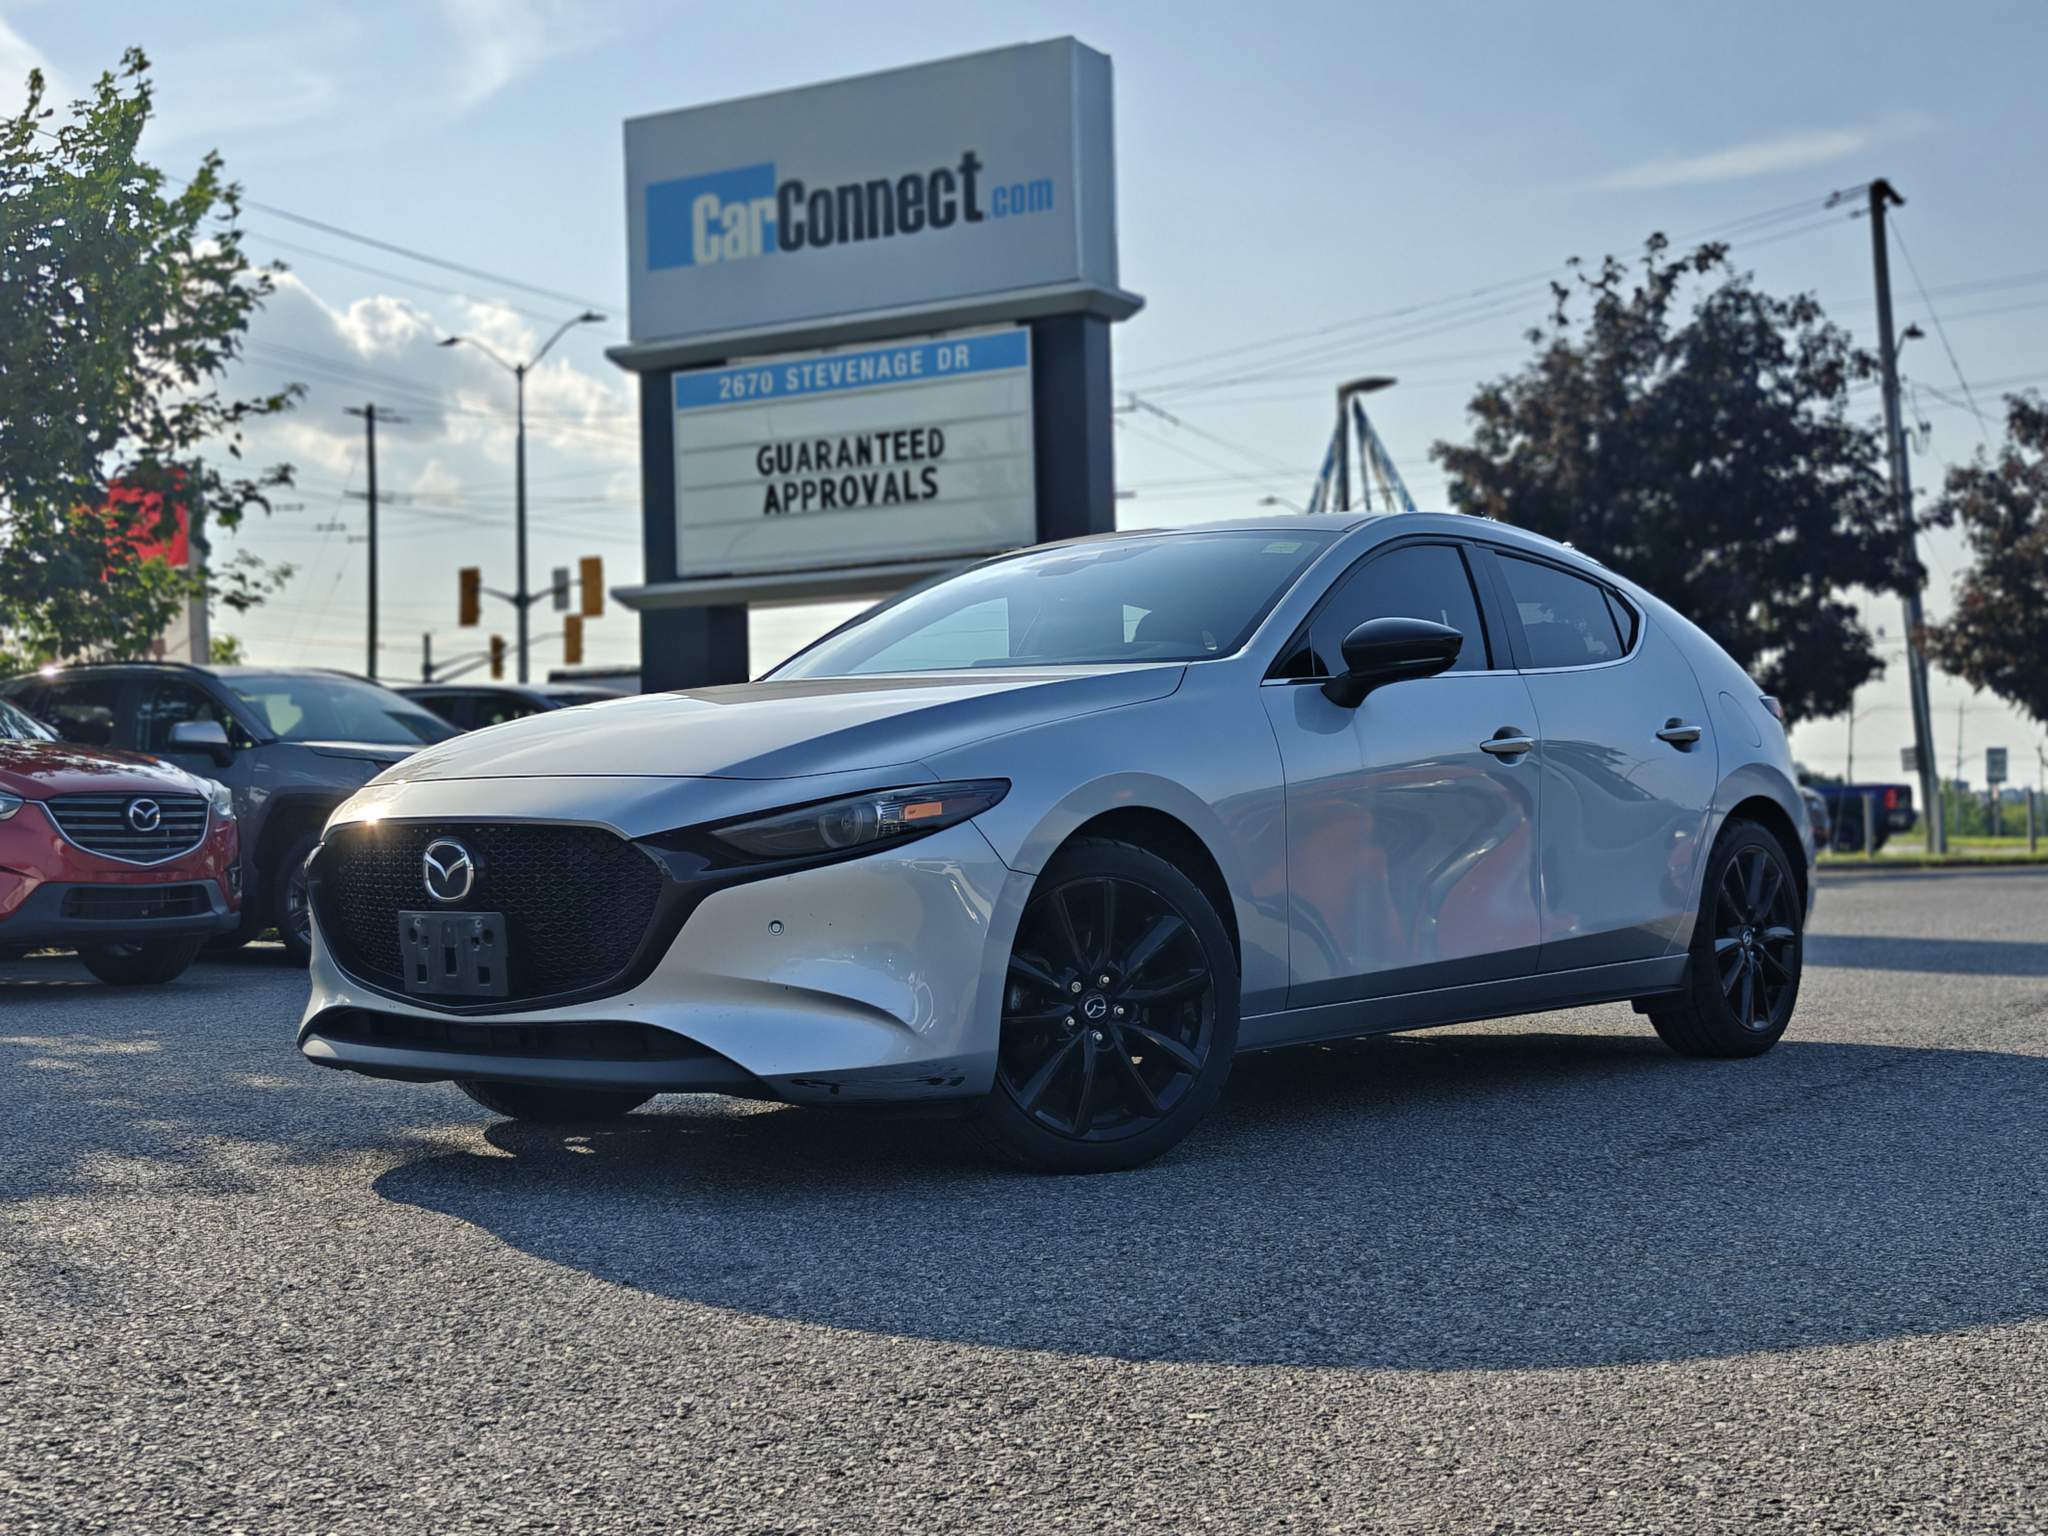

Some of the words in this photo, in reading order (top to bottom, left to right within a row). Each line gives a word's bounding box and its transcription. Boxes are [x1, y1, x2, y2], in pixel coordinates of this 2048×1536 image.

[692, 151, 1053, 265] CarConnect.com
[719, 372, 774, 399] 2670
[786, 351, 924, 390] STEVENAGE
[938, 345, 970, 370] DR
[757, 428, 945, 476] GUARANTEED
[763, 467, 939, 515] APPROVALS
